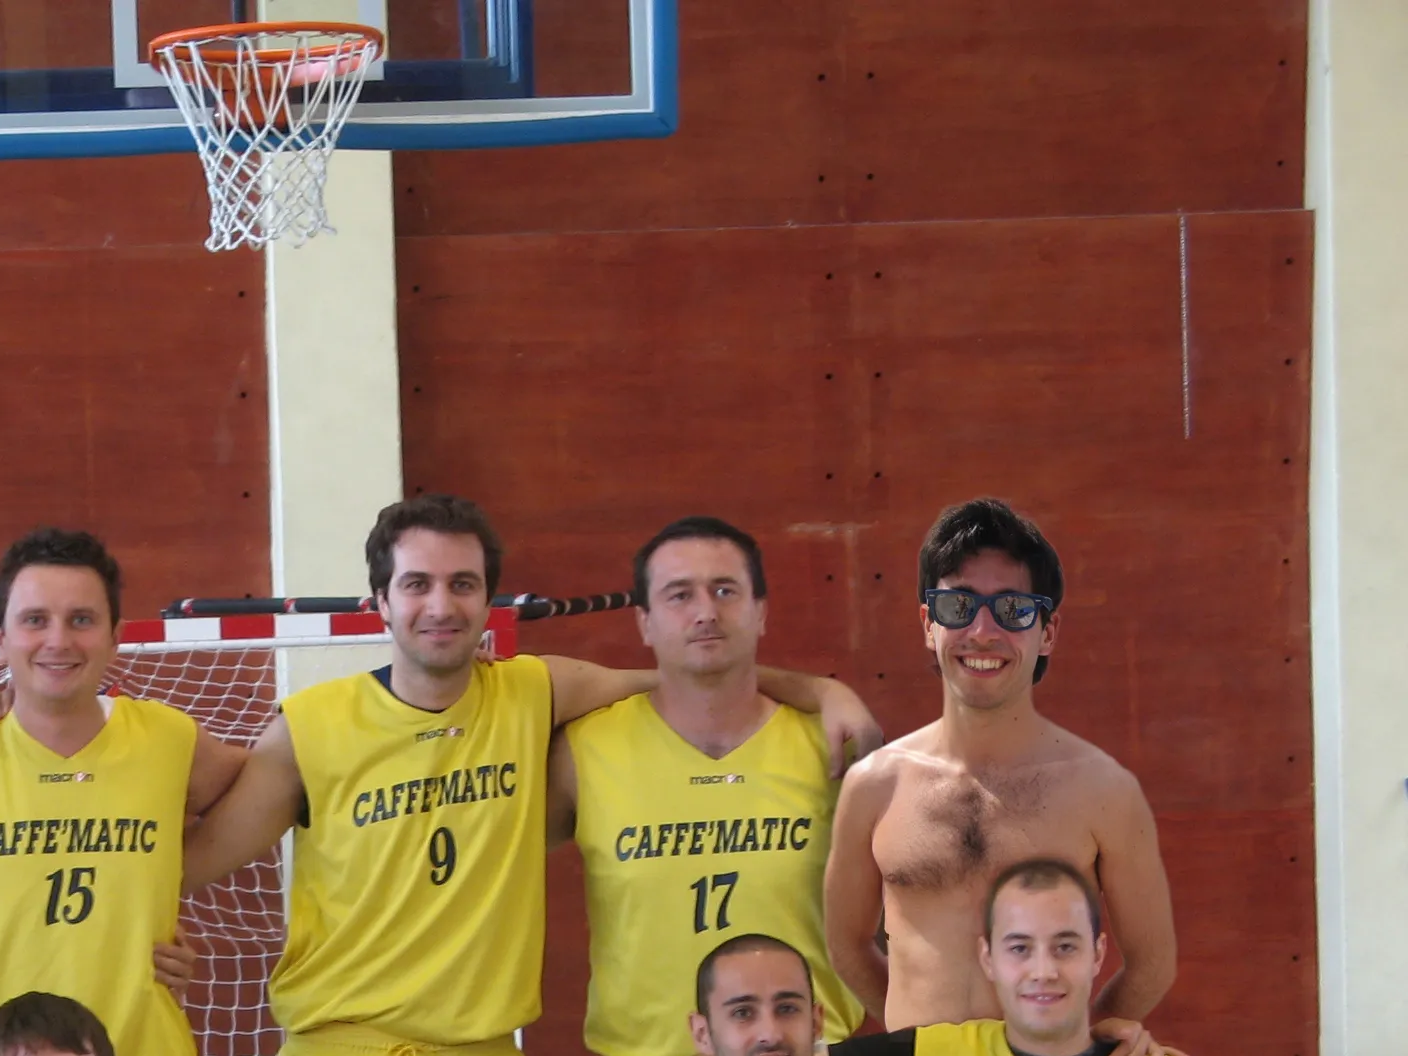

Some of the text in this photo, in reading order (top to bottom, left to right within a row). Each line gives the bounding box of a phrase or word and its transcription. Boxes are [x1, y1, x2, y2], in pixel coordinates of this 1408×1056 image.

[415, 727, 465, 742] macron
[39, 773, 93, 783] macron
[353, 762, 516, 828] CAFFE'MATIC
[690, 775, 745, 785] macron
[428, 826, 457, 886] 9
[615, 817, 813, 862] CAFFE'MATIC
[45, 866, 96, 926] 15
[690, 871, 739, 935] 17
